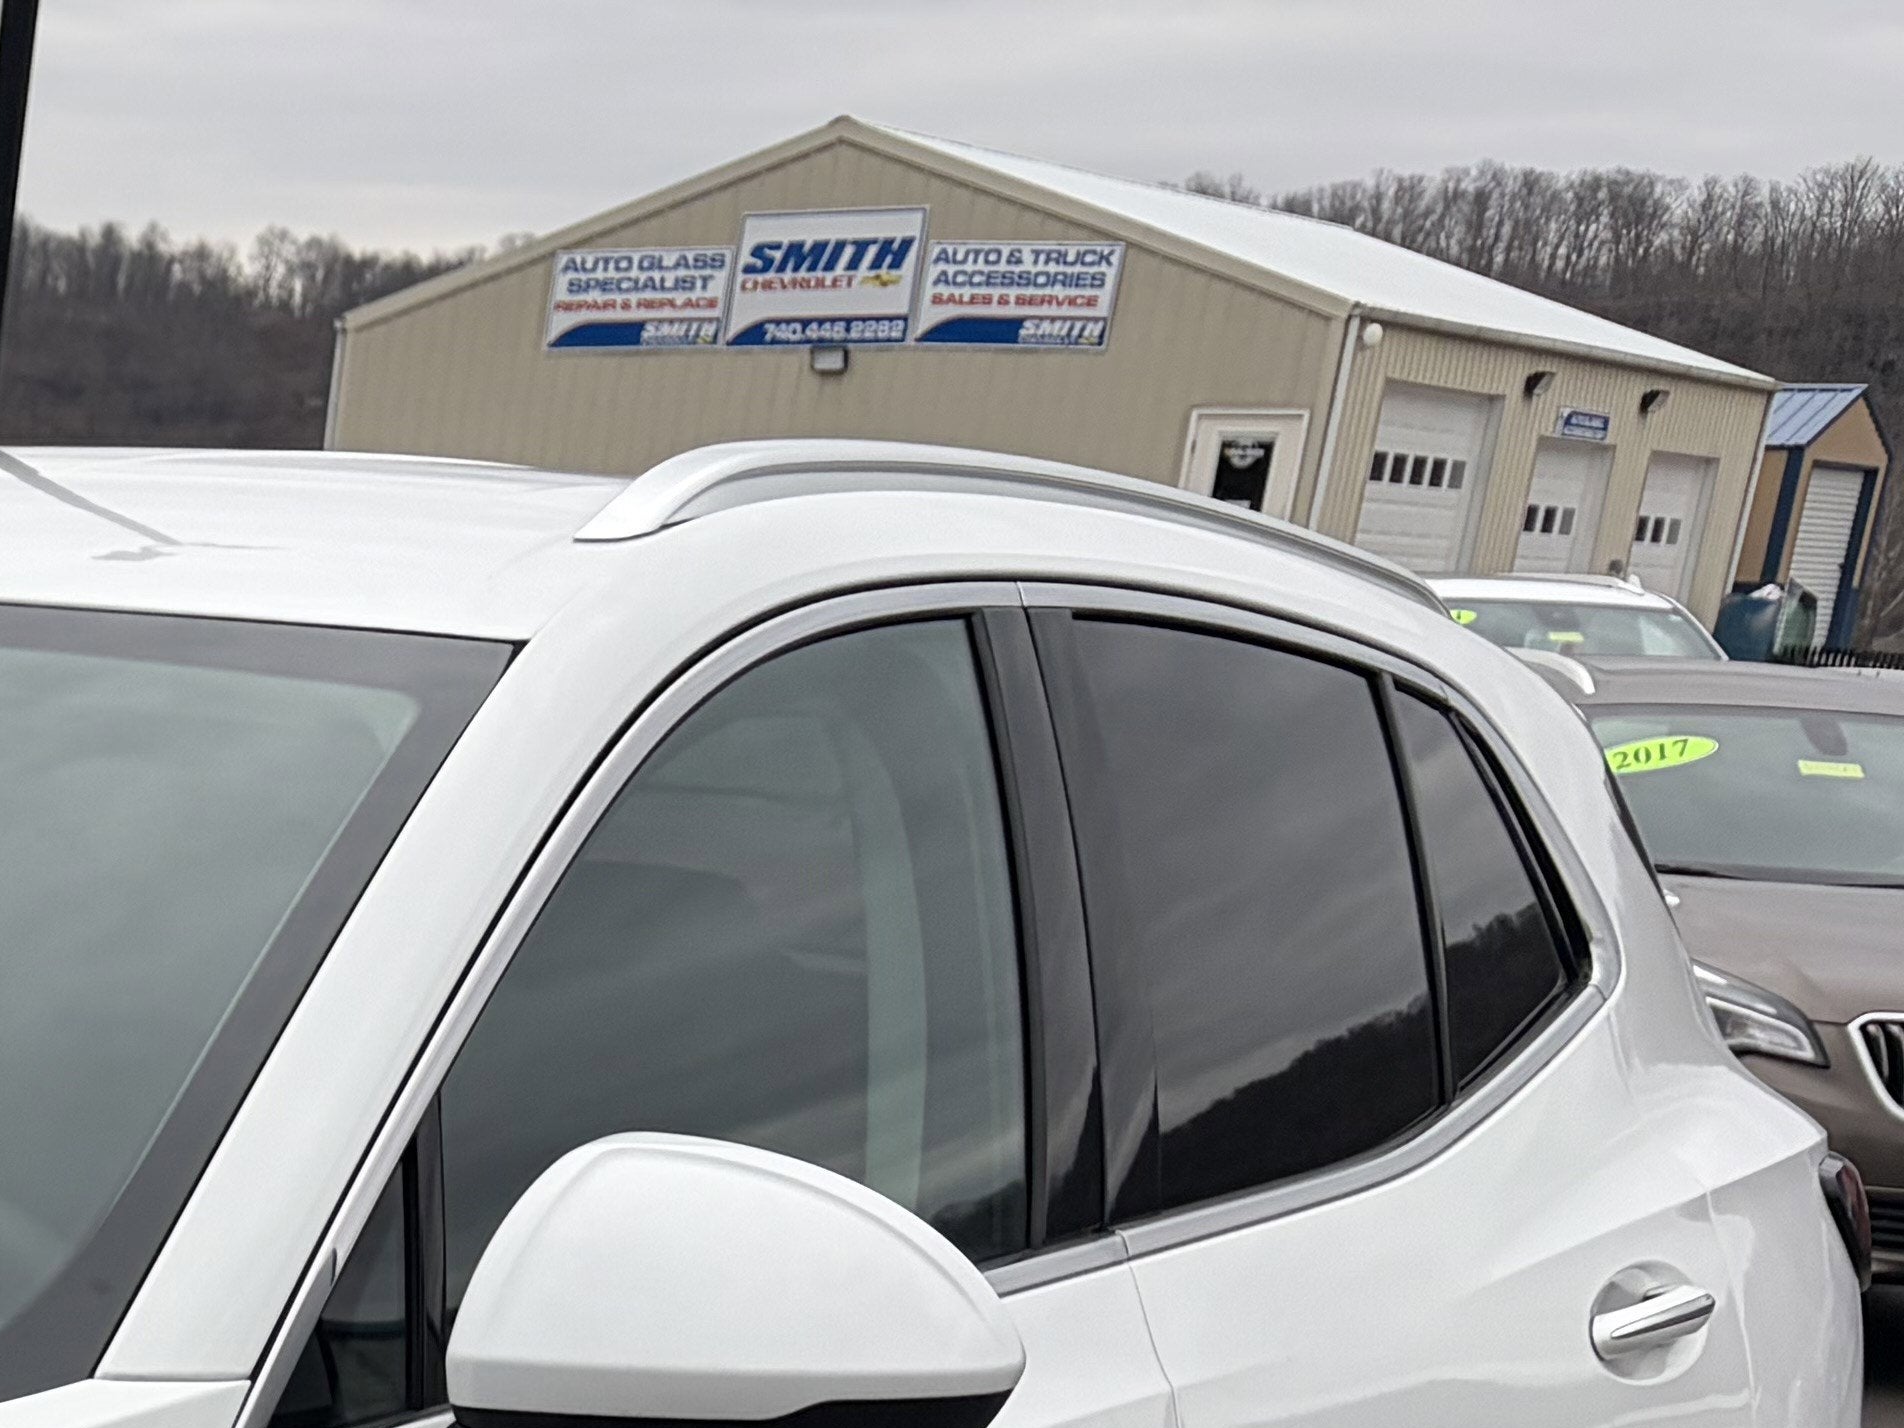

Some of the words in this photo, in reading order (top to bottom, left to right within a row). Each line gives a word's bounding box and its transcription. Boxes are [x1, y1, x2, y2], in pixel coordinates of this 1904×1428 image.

[562, 256, 633, 274] AUTO
[637, 253, 725, 271] GLASS
[742, 236, 915, 273] SMITH
[933, 248, 1001, 265] AUTO
[1006, 248, 1023, 264] &
[1031, 249, 1114, 267] TRUCK
[567, 275, 714, 295] SPECIALIST
[741, 275, 857, 293] CHEVROLET
[932, 270, 1106, 288] ACCESSORIES
[554, 299, 616, 312] REPAIR
[636, 297, 719, 310] REPLACE
[931, 293, 993, 306] SALES
[997, 294, 1010, 306] &
[1015, 294, 1099, 308] SERVICE
[644, 321, 720, 337] SMITH
[1021, 319, 1105, 336] SMITH
[1612, 739, 1690, 771] 2017
